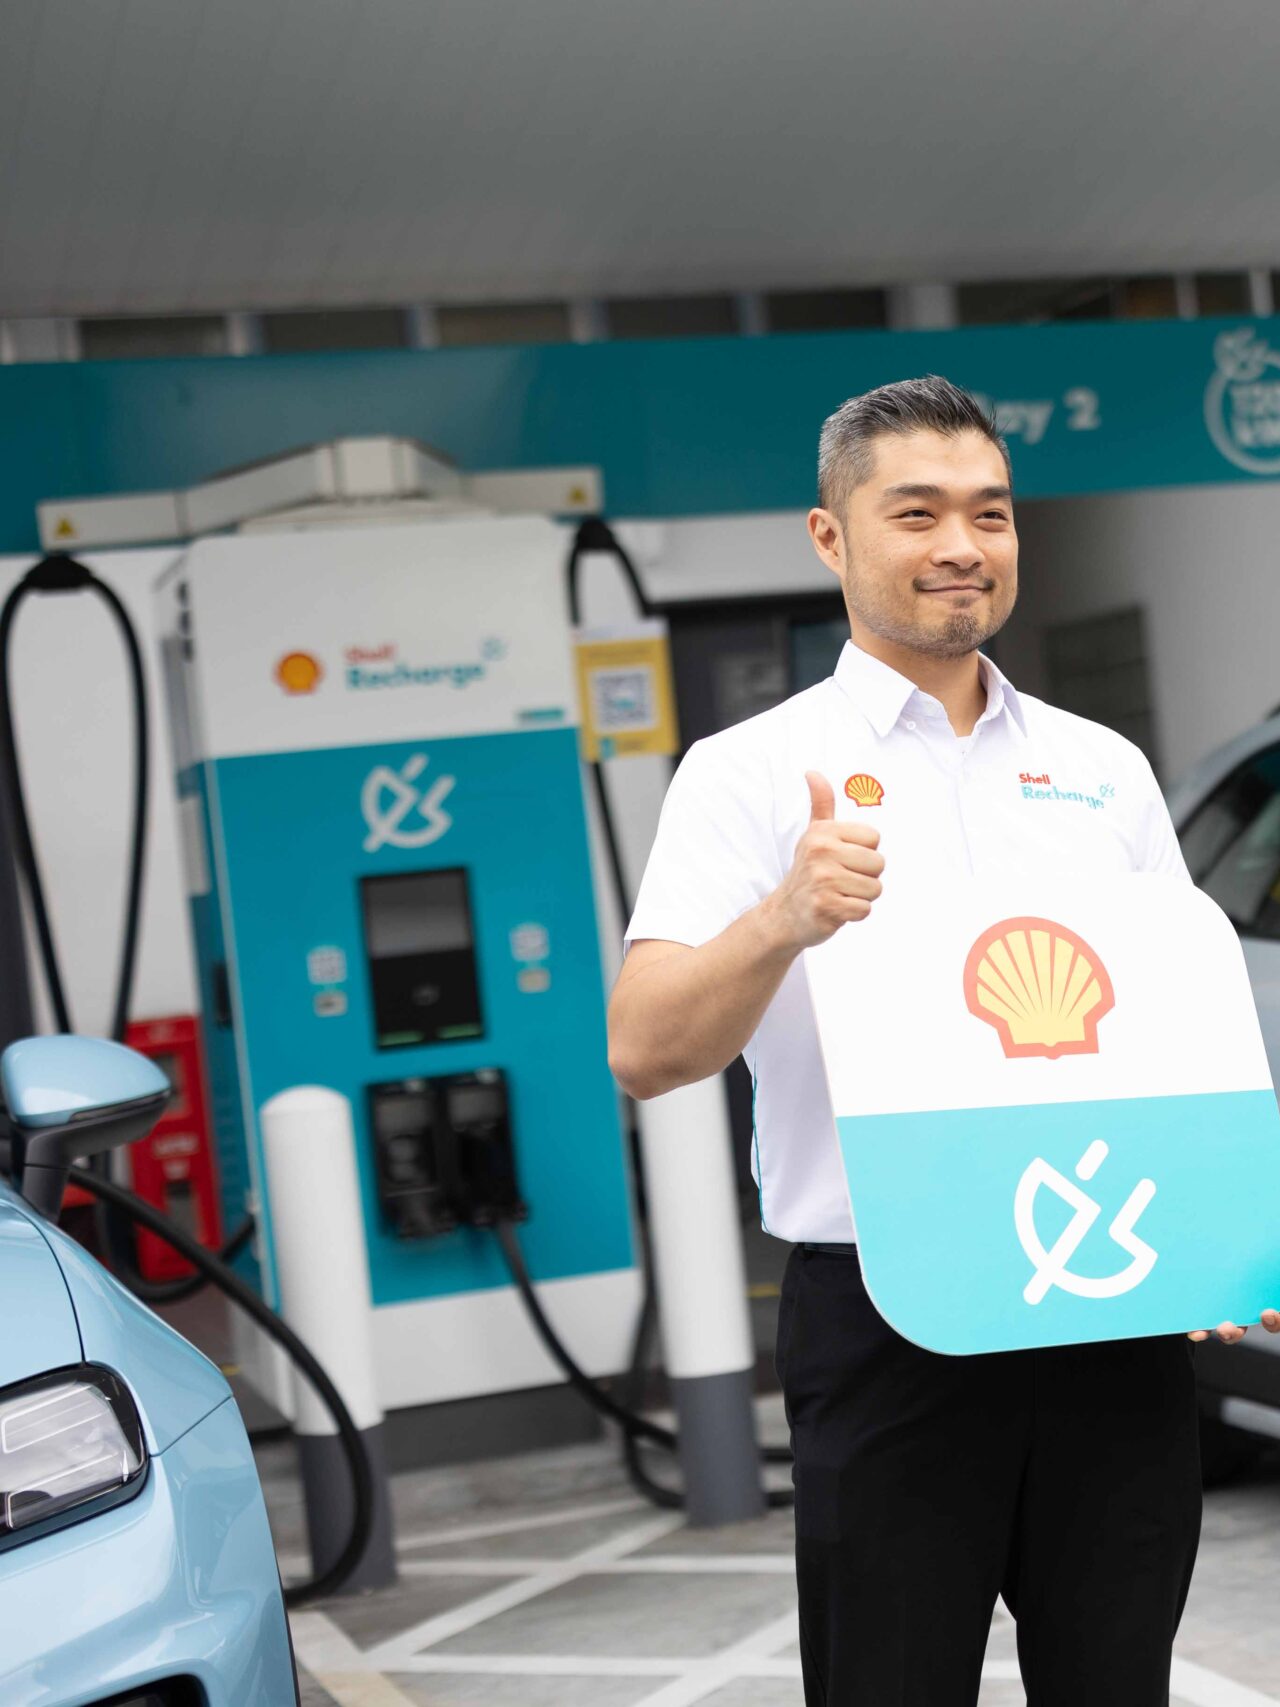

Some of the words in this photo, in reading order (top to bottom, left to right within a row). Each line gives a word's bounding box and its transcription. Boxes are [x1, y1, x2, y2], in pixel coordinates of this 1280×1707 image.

[1063, 386, 1100, 430] 2
[346, 662, 486, 690] Recharge
[1019, 772, 1051, 785] Shell
[1021, 784, 1105, 810] Recharge
